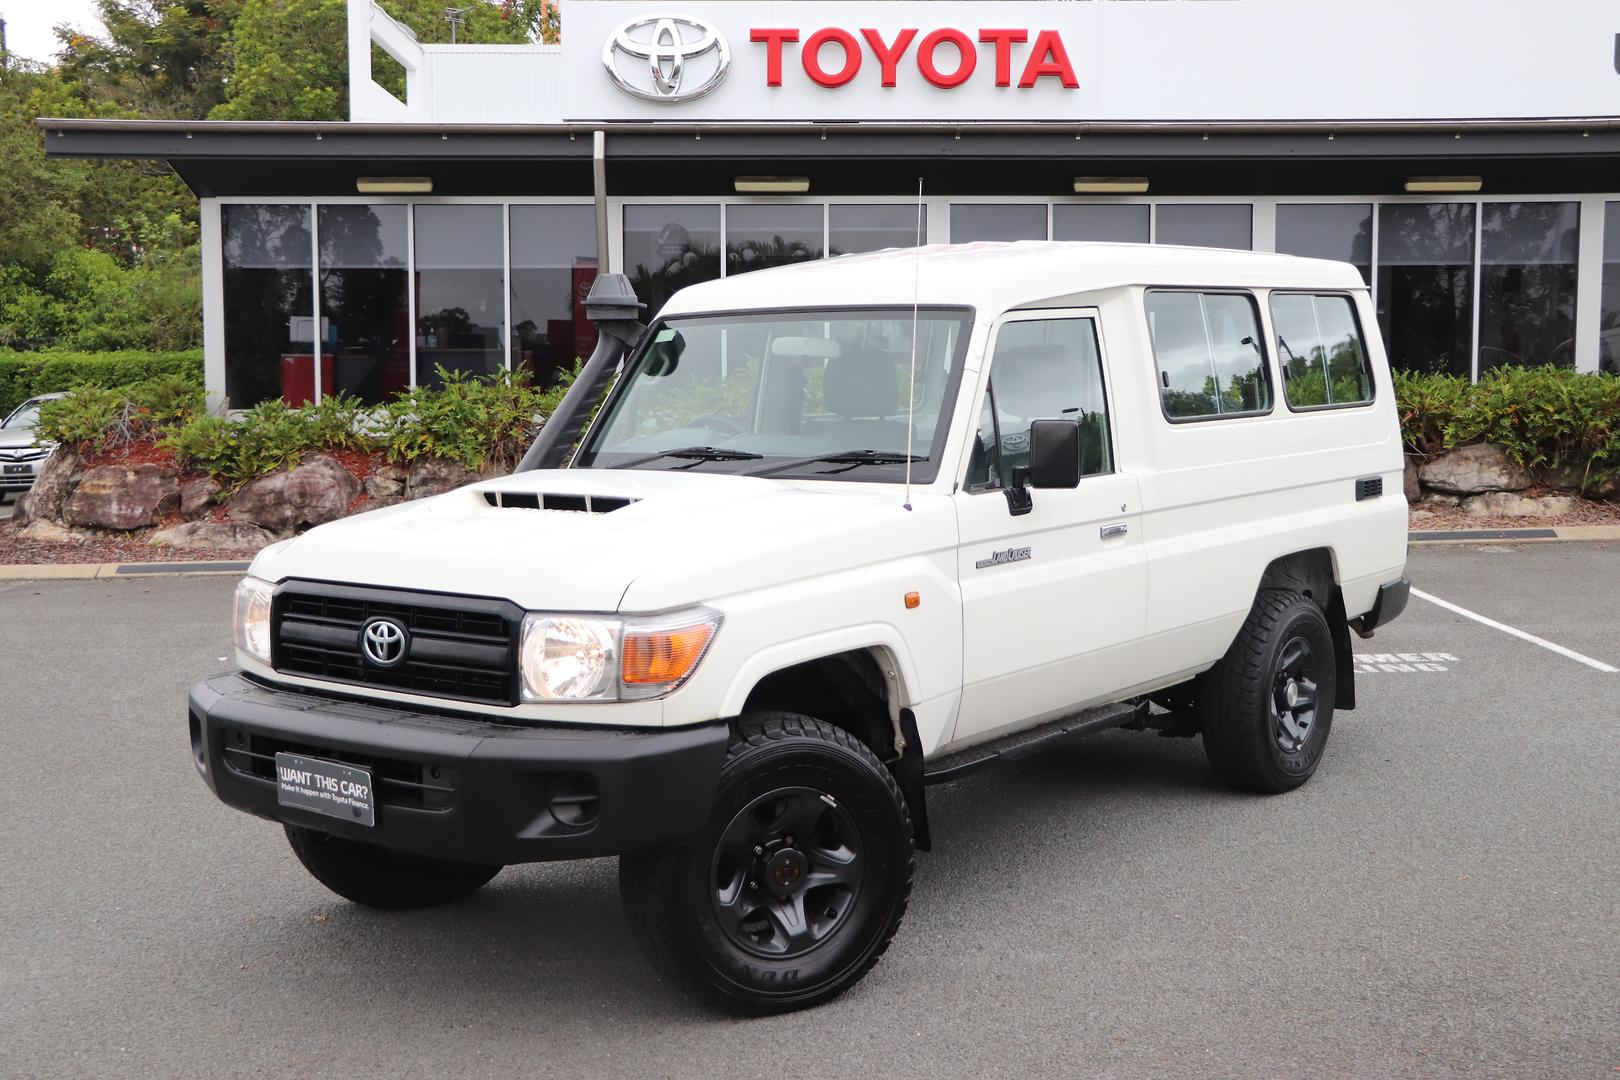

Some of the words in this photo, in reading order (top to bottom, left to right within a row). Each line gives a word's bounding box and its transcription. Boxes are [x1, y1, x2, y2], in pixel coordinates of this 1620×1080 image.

[750, 27, 1080, 89] TOYOTA
[280, 767, 312, 786] WANT
[314, 774, 338, 792] THIS
[340, 781, 368, 799] CAR?
[281, 783, 295, 792] Make
[300, 787, 319, 797] happen
[320, 791, 332, 800] with
[332, 793, 348, 804] Toyota
